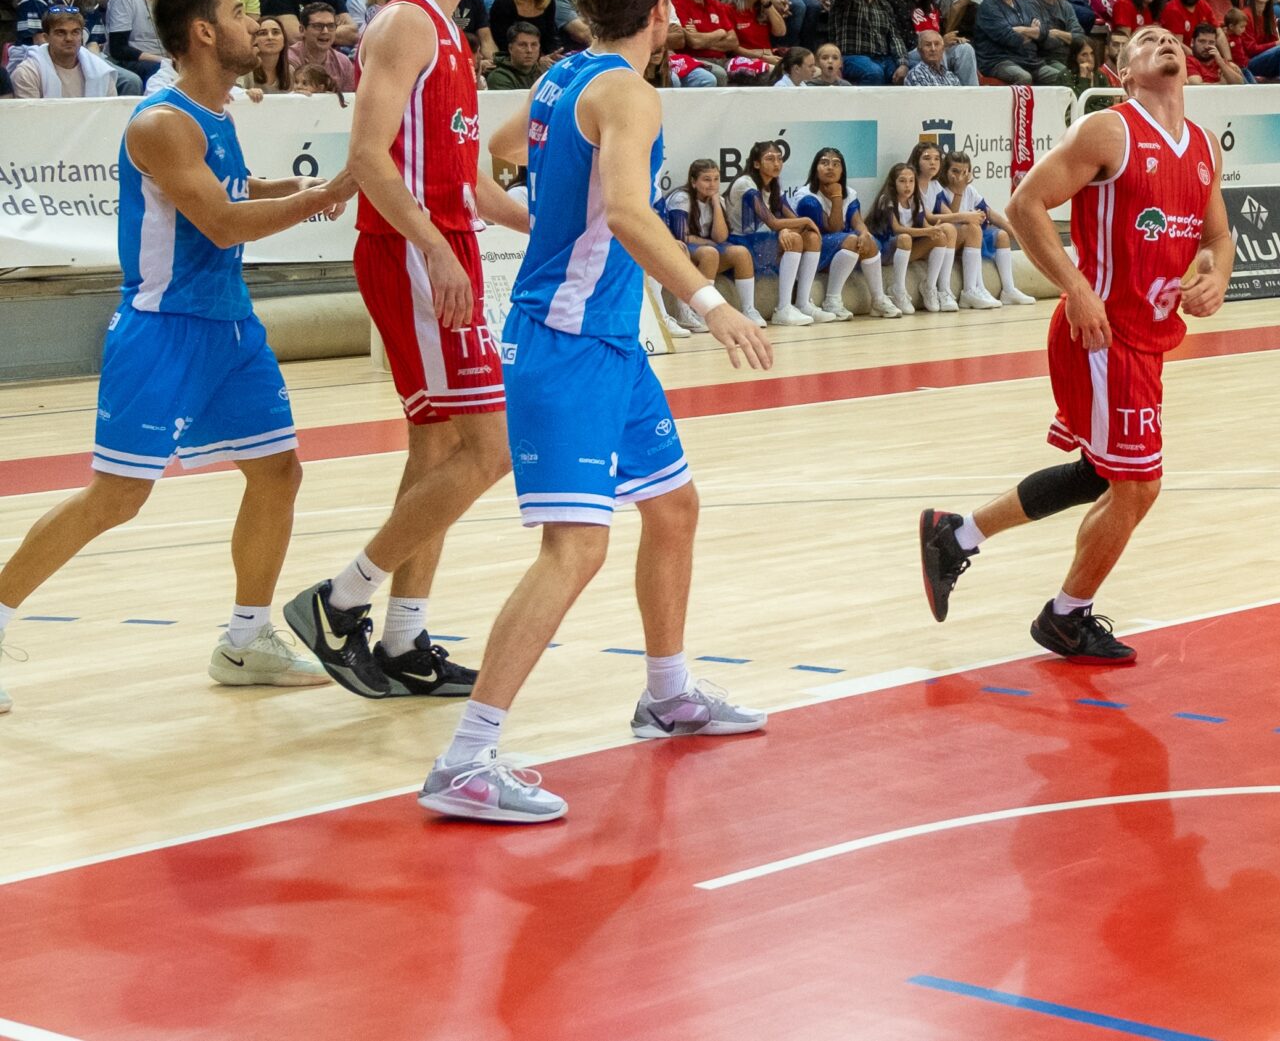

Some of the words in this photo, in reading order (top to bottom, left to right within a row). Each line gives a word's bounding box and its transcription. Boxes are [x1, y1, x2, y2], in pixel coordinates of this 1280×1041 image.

[963, 133, 1052, 158] Ajuntaent
[0, 160, 119, 190] Ajuntame
[987, 161, 1012, 179] Ben
[1220, 171, 1242, 182] carló
[2, 195, 37, 216] de
[40, 193, 119, 217] Benica
[480, 251, 526, 263] o@hotmail
[450, 325, 497, 358] TR
